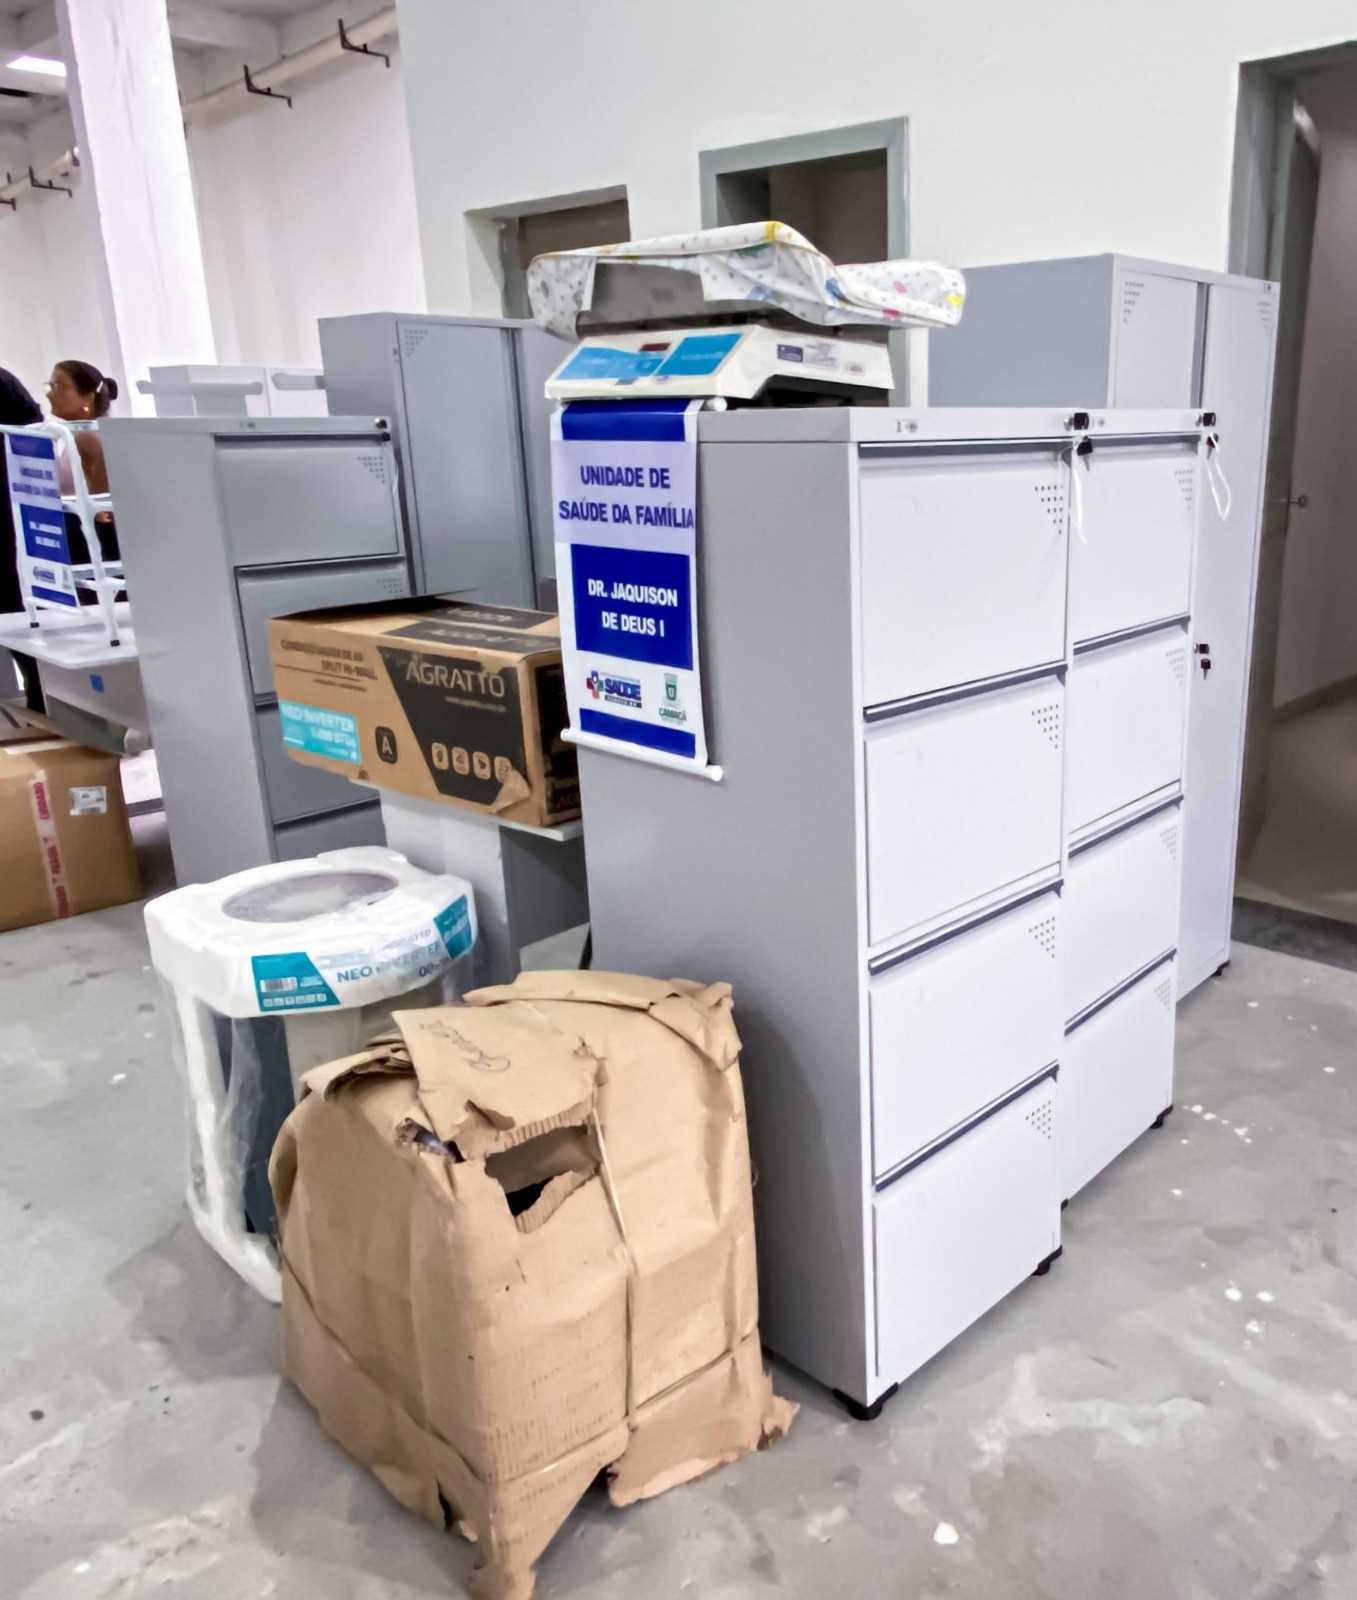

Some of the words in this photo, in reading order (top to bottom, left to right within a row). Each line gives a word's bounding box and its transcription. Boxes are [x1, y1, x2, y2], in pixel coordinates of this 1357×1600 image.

[580, 465, 645, 487] UNIDADE
[649, 467, 671, 489] DE
[559, 497, 608, 522] SAÚDE
[612, 503, 632, 525] DA
[635, 502, 694, 529] FAMÍLIA
[587, 578, 608, 598] DR.
[610, 582, 678, 607] JAQUISON
[602, 611, 618, 630] DE
[621, 614, 656, 636] DEUS
[406, 657, 505, 698] AGRATTO
[382, 735, 393, 756] A
[336, 965, 373, 983] NEO
